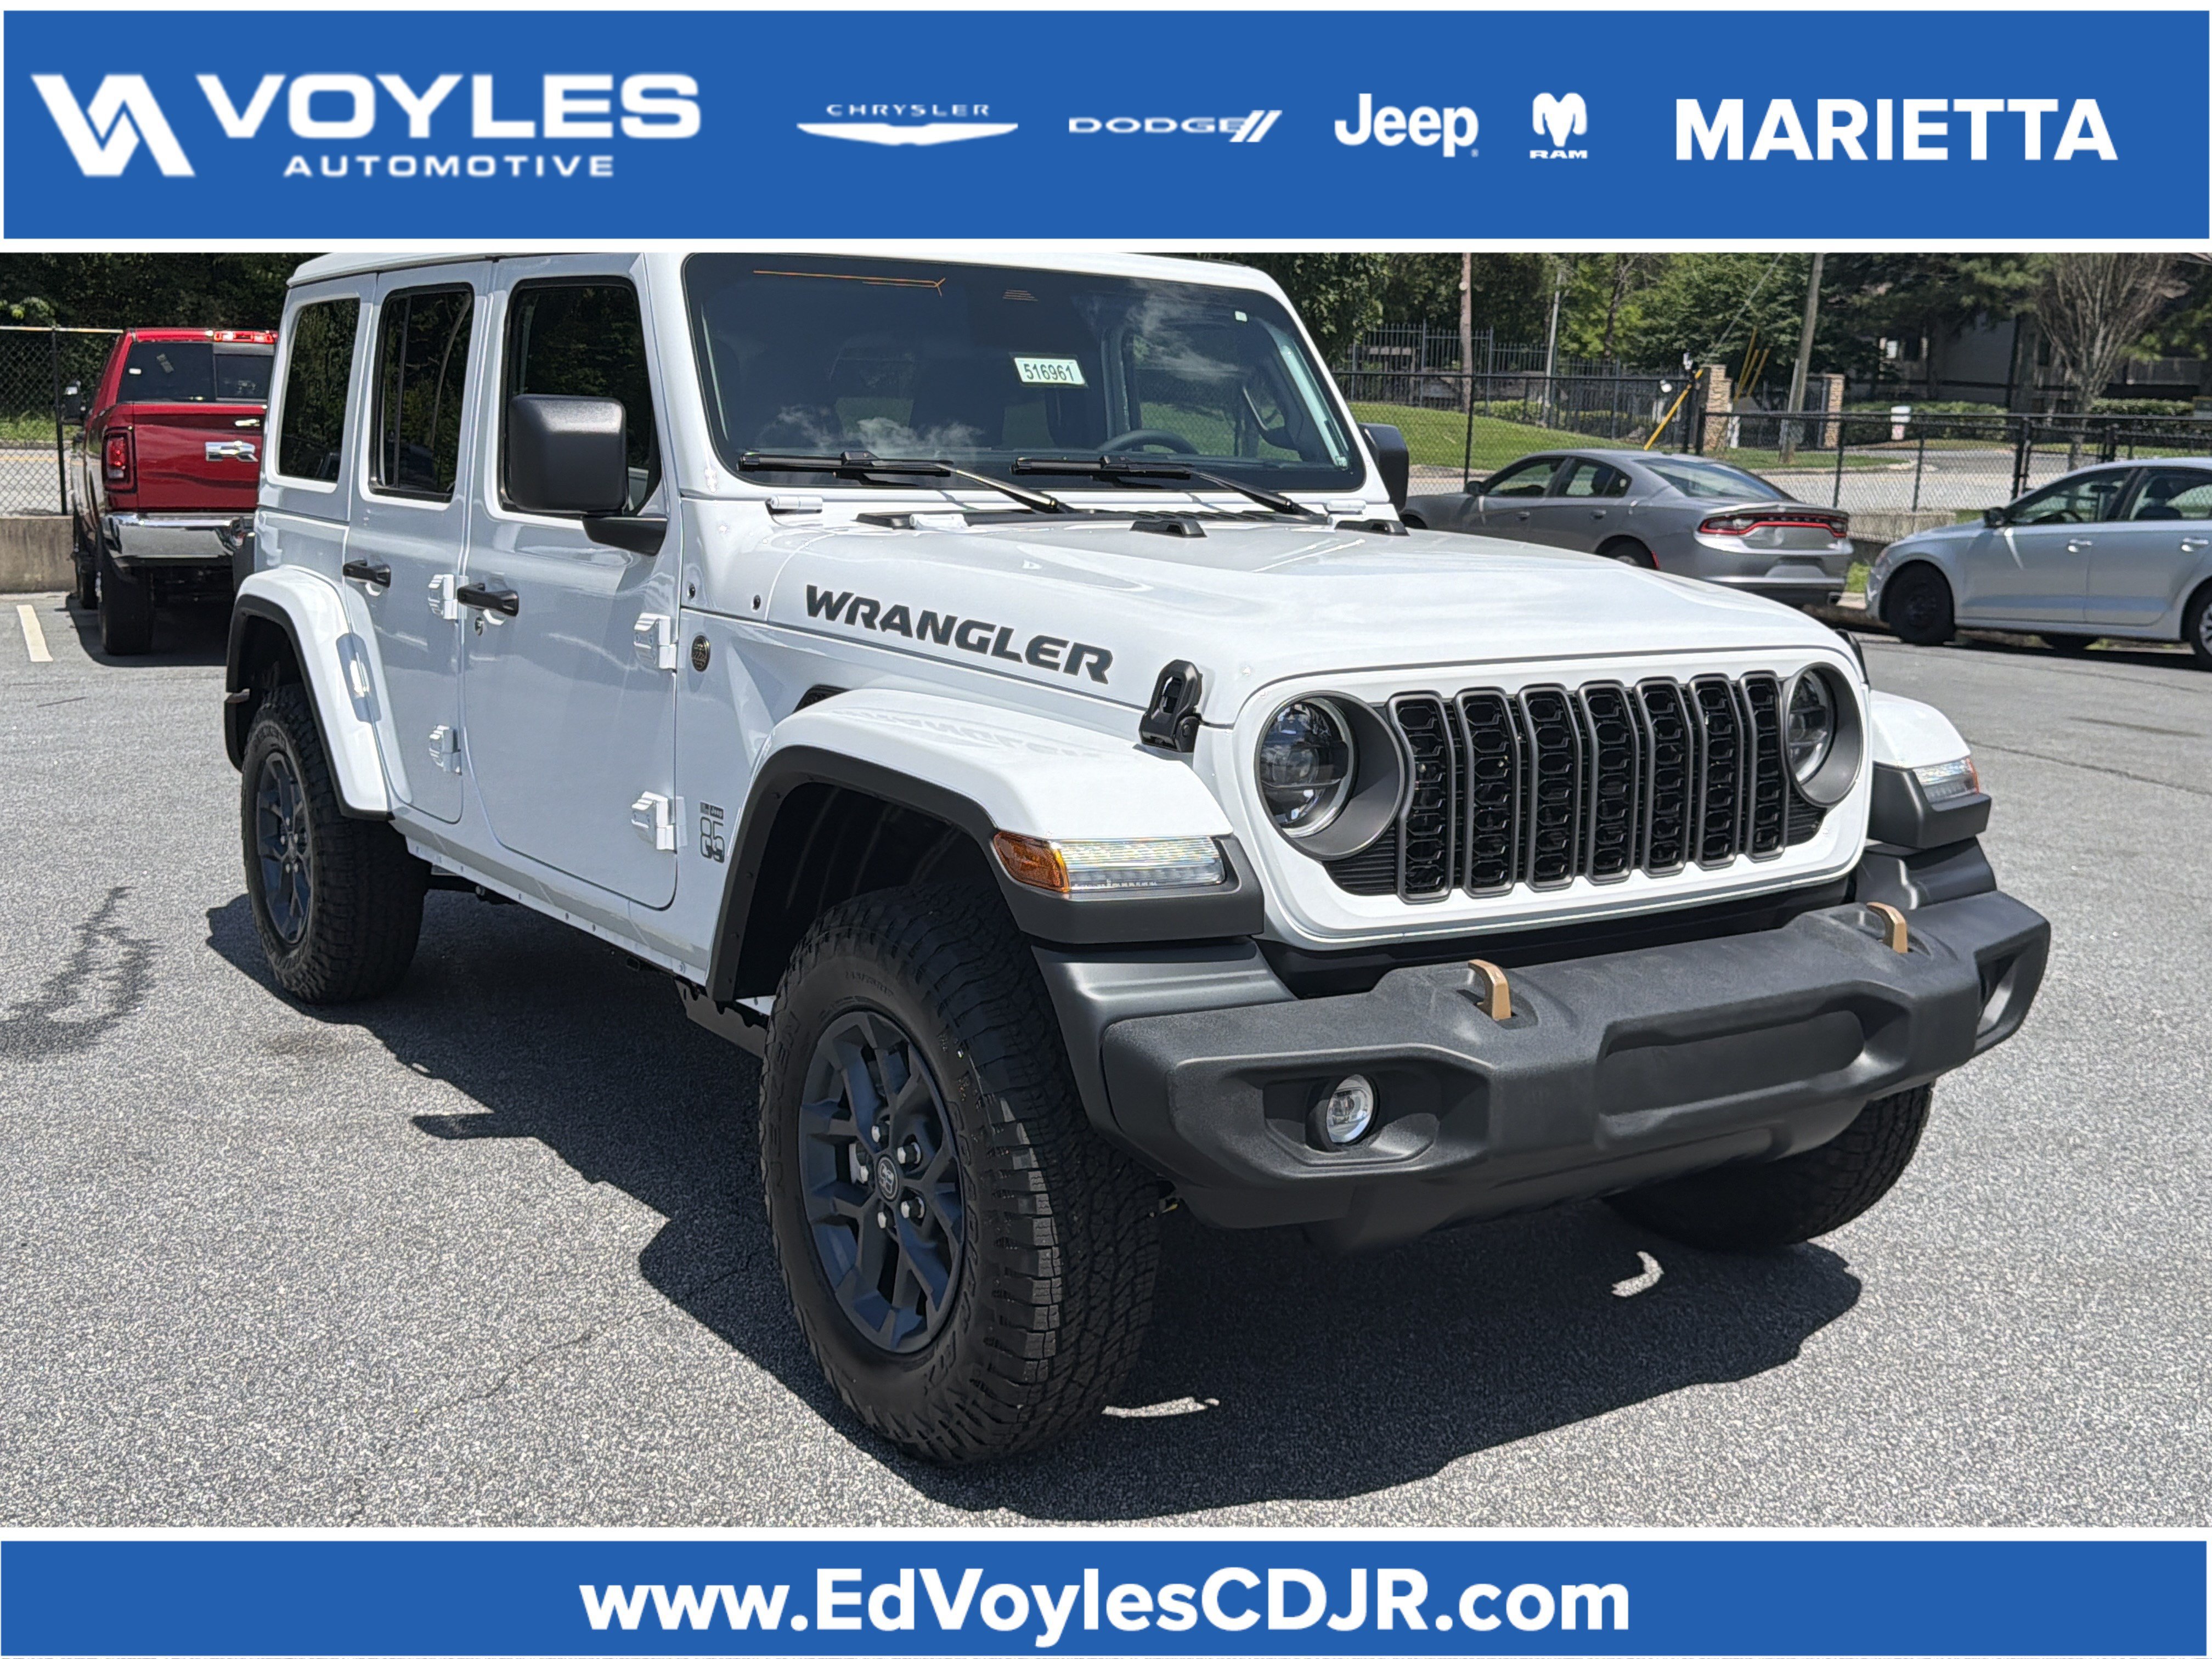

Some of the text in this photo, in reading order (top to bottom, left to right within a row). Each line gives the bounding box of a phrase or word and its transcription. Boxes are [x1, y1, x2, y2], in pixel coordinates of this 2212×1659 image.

[1023, 363, 1074, 382] 516961
[806, 585, 1113, 684] WRANGLER
[701, 816, 725, 863] 85
